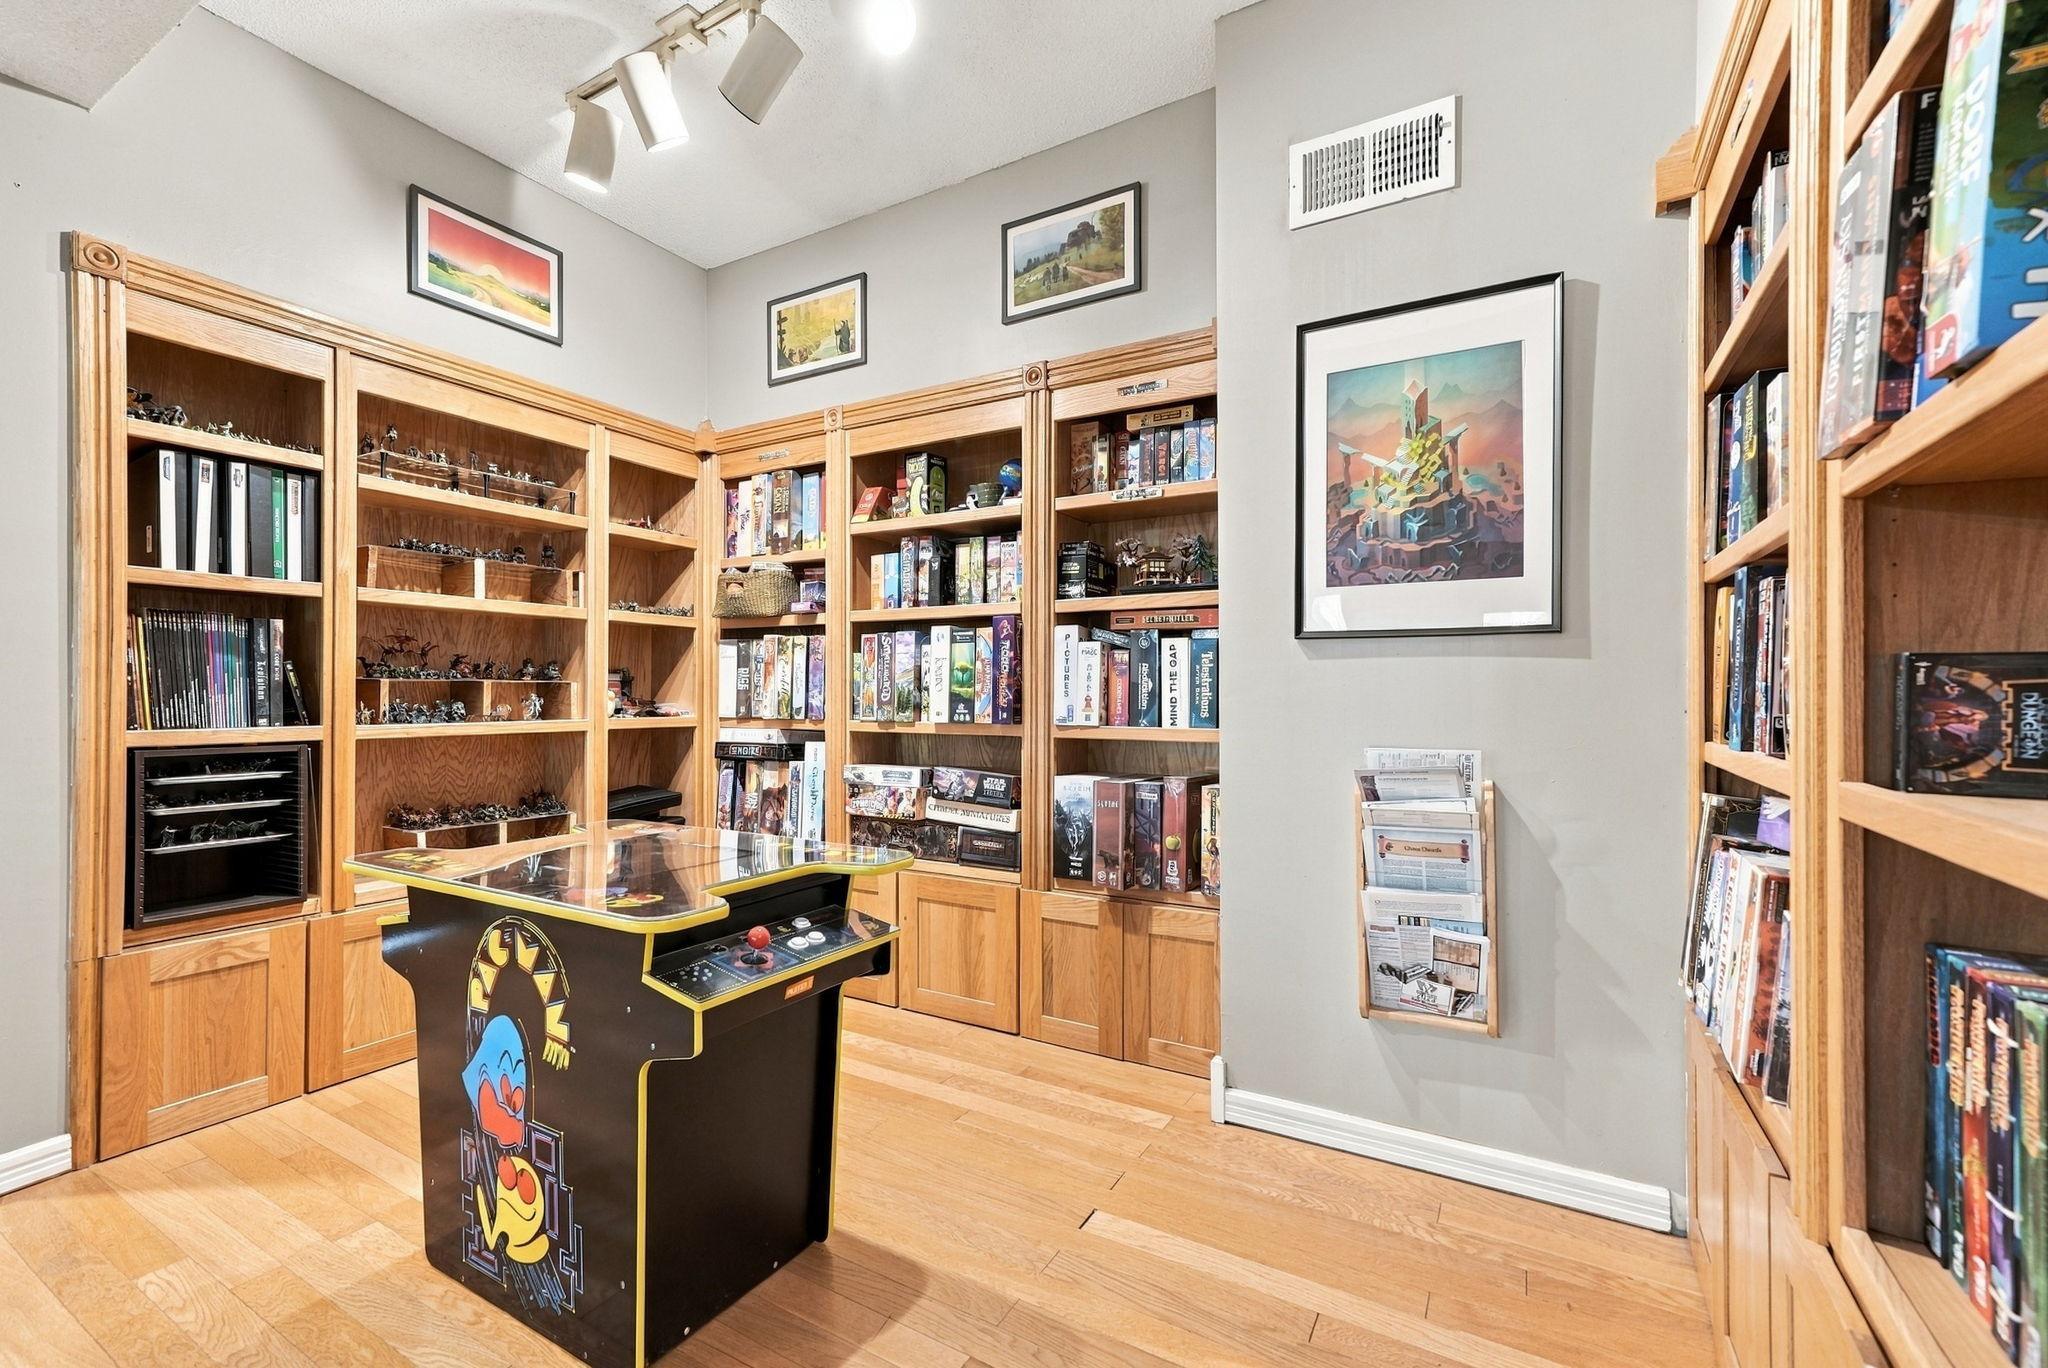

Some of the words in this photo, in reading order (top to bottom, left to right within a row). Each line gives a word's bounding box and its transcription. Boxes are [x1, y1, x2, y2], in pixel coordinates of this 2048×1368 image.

[1063, 633, 1071, 698] PICTURES
[1169, 644, 1178, 668] GAP
[256, 660, 266, 700] Leviathan
[1169, 669, 1178, 694] THE
[1200, 651, 1214, 719] Telestrations
[1169, 697, 1178, 727] MIND
[2020, 691, 2041, 760] DUNGEON
[983, 776, 1006, 786] STAR
[983, 783, 1007, 792] WARS
[959, 808, 1011, 824] MINIATURES
